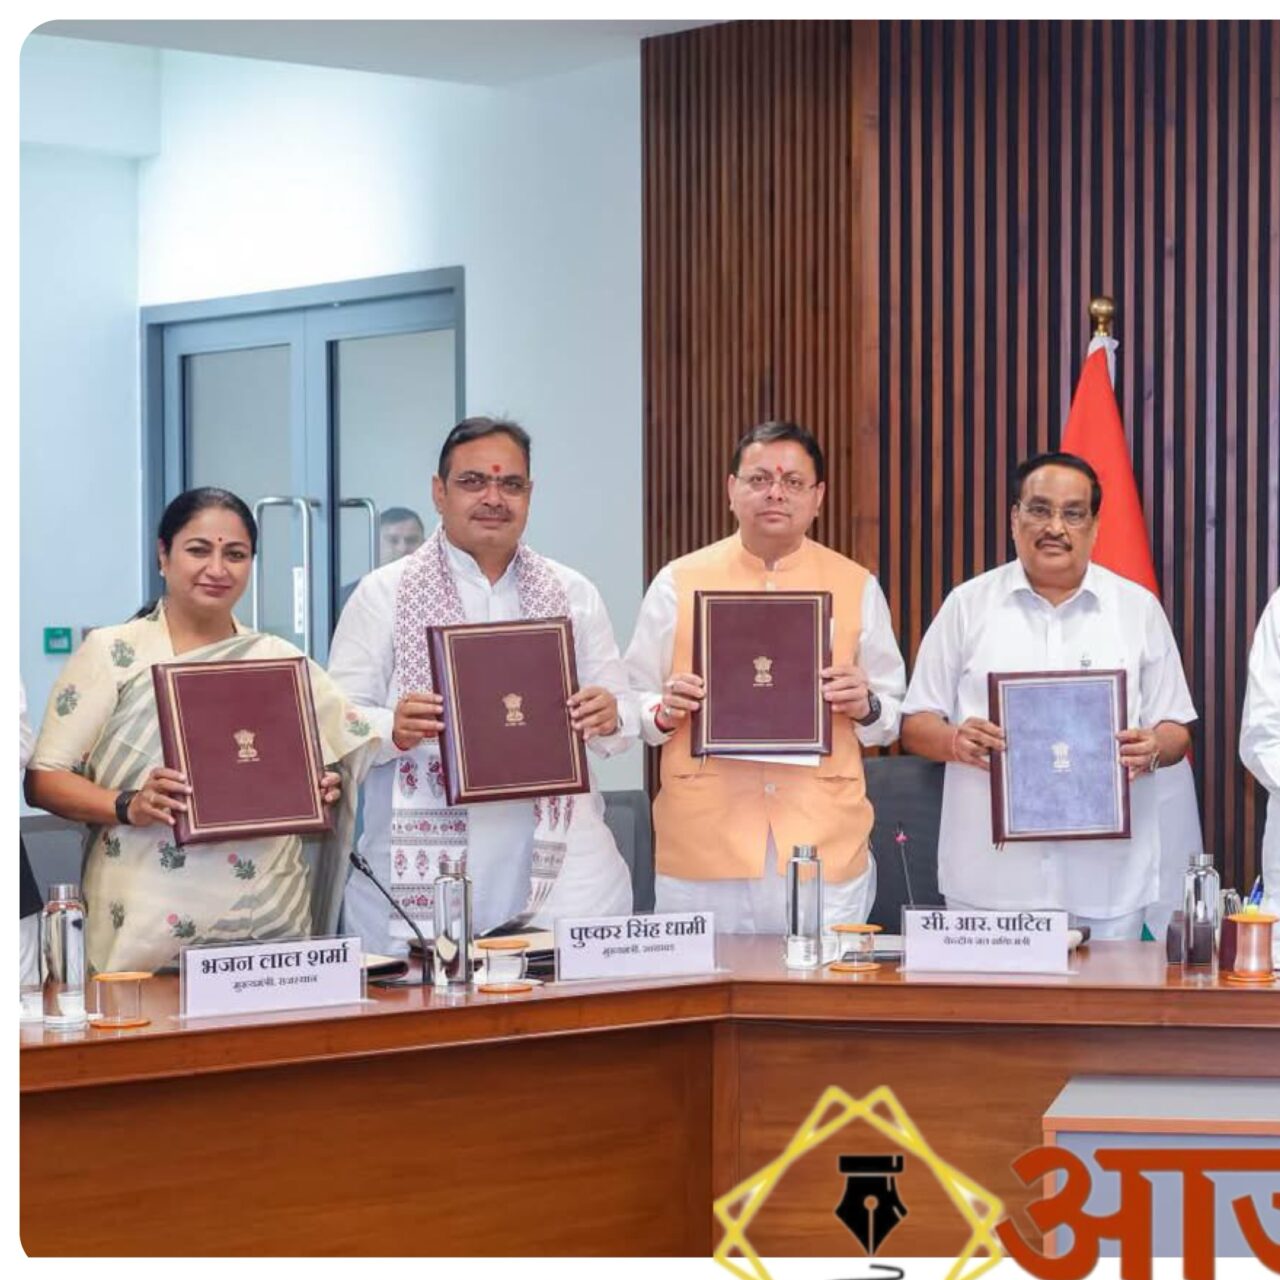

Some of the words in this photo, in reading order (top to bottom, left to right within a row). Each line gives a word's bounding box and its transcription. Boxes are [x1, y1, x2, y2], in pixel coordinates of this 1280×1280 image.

[569, 924, 623, 949] पुष्कर
[626, 917, 662, 940] सिंह
[665, 914, 708, 937] धामी
[920, 911, 950, 932] सी.
[955, 915, 991, 932] आर.
[996, 911, 1053, 933] पाटिल
[201, 955, 254, 975] भजन
[259, 950, 303, 969] लाल
[307, 941, 351, 967] शर्मा
